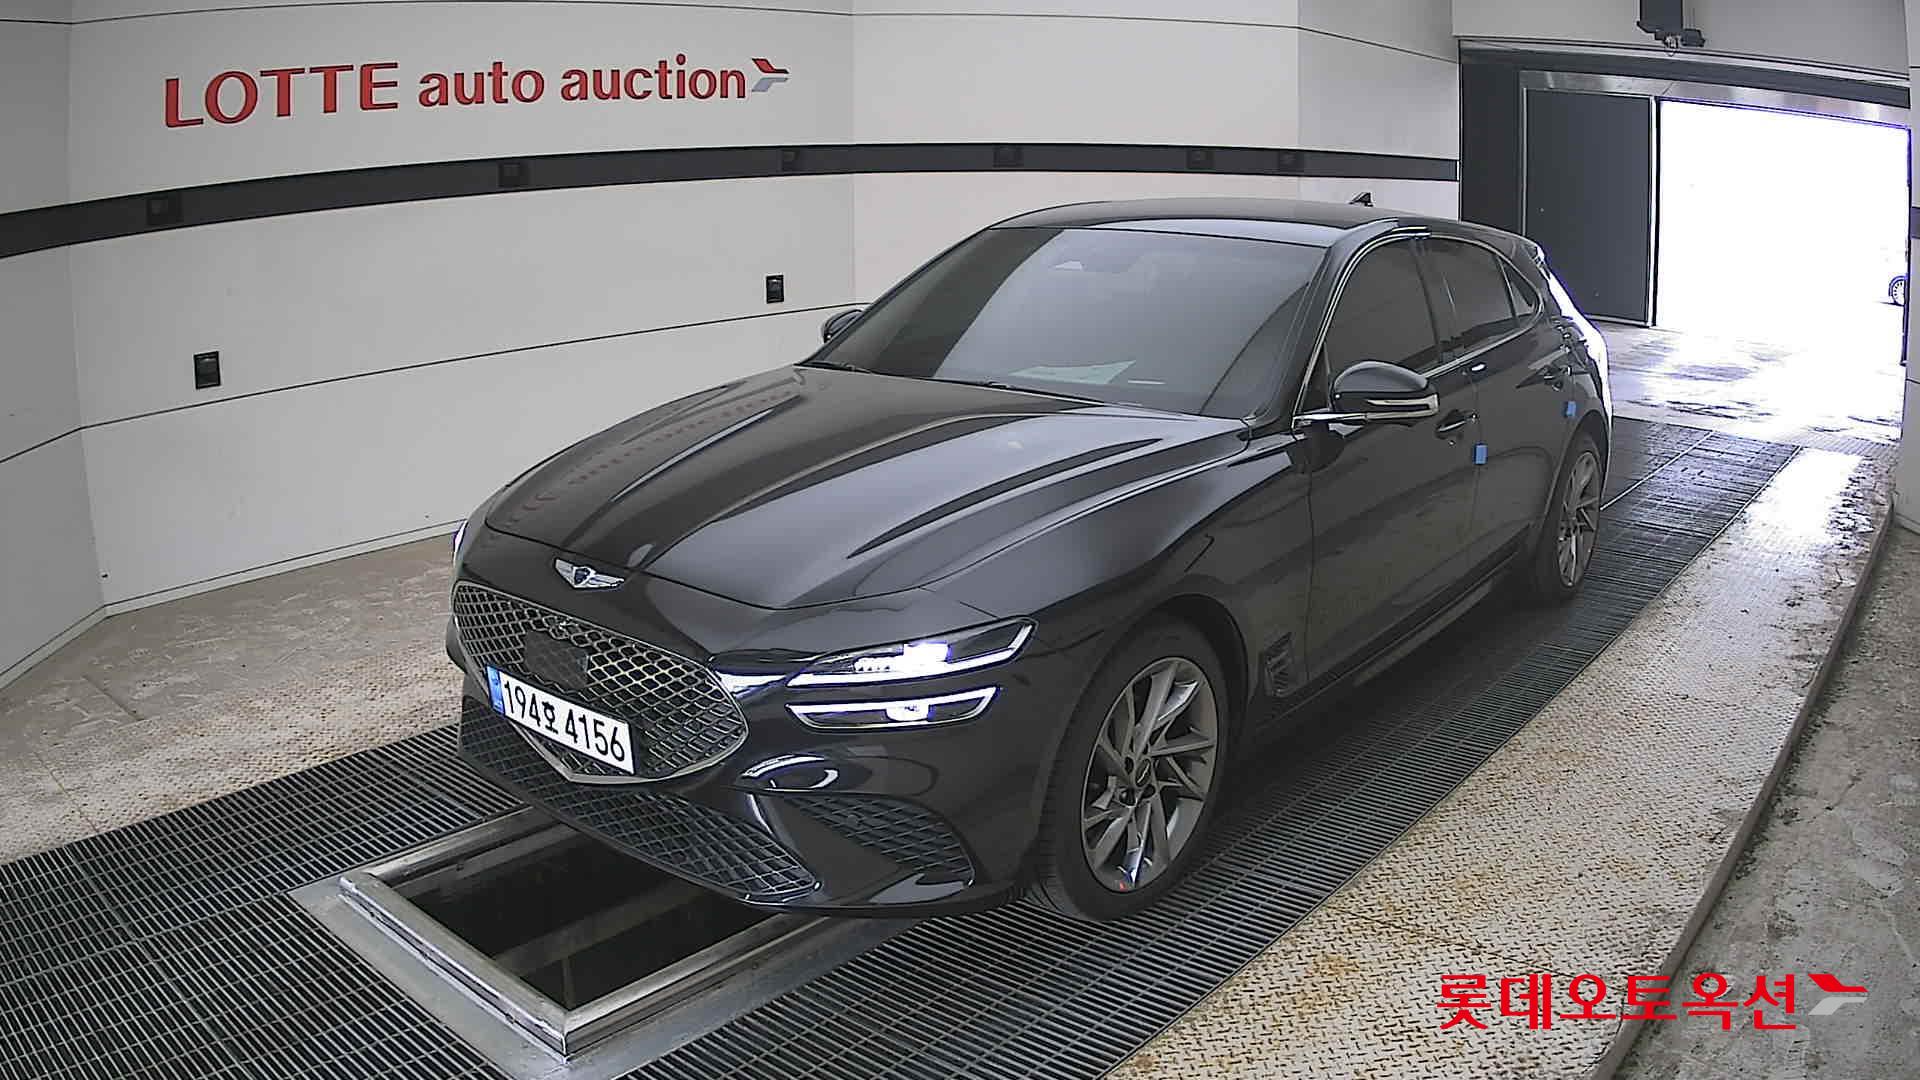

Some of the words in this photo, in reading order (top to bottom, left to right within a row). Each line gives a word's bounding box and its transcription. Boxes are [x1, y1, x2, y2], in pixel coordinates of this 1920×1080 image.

[164, 62, 399, 128] LOTTE
[419, 61, 545, 107] auto
[560, 54, 746, 99] auction
[504, 681, 559, 734] 194호
[565, 709, 625, 762] 4156
